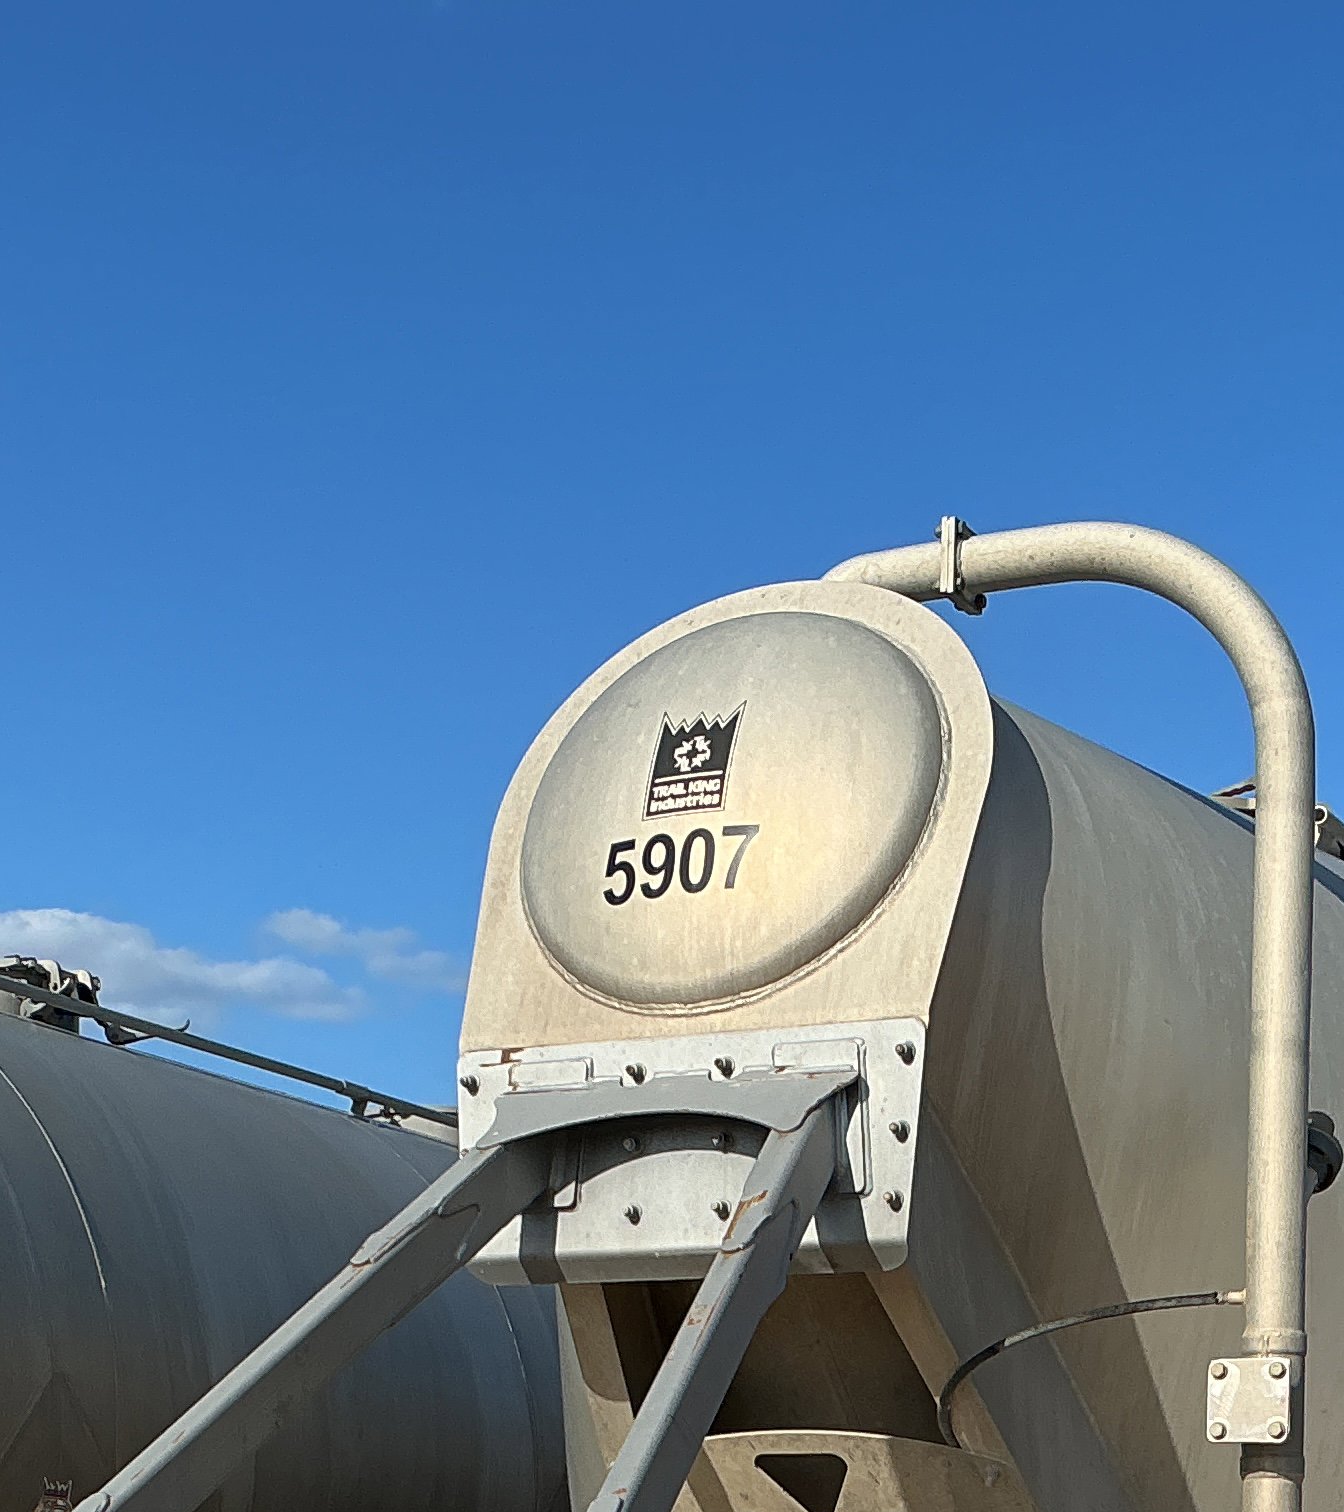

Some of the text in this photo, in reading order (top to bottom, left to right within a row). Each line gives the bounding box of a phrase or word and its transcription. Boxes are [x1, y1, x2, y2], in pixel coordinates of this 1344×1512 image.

[652, 778, 721, 798] TRAIL KING
[603, 824, 760, 906] 5907
